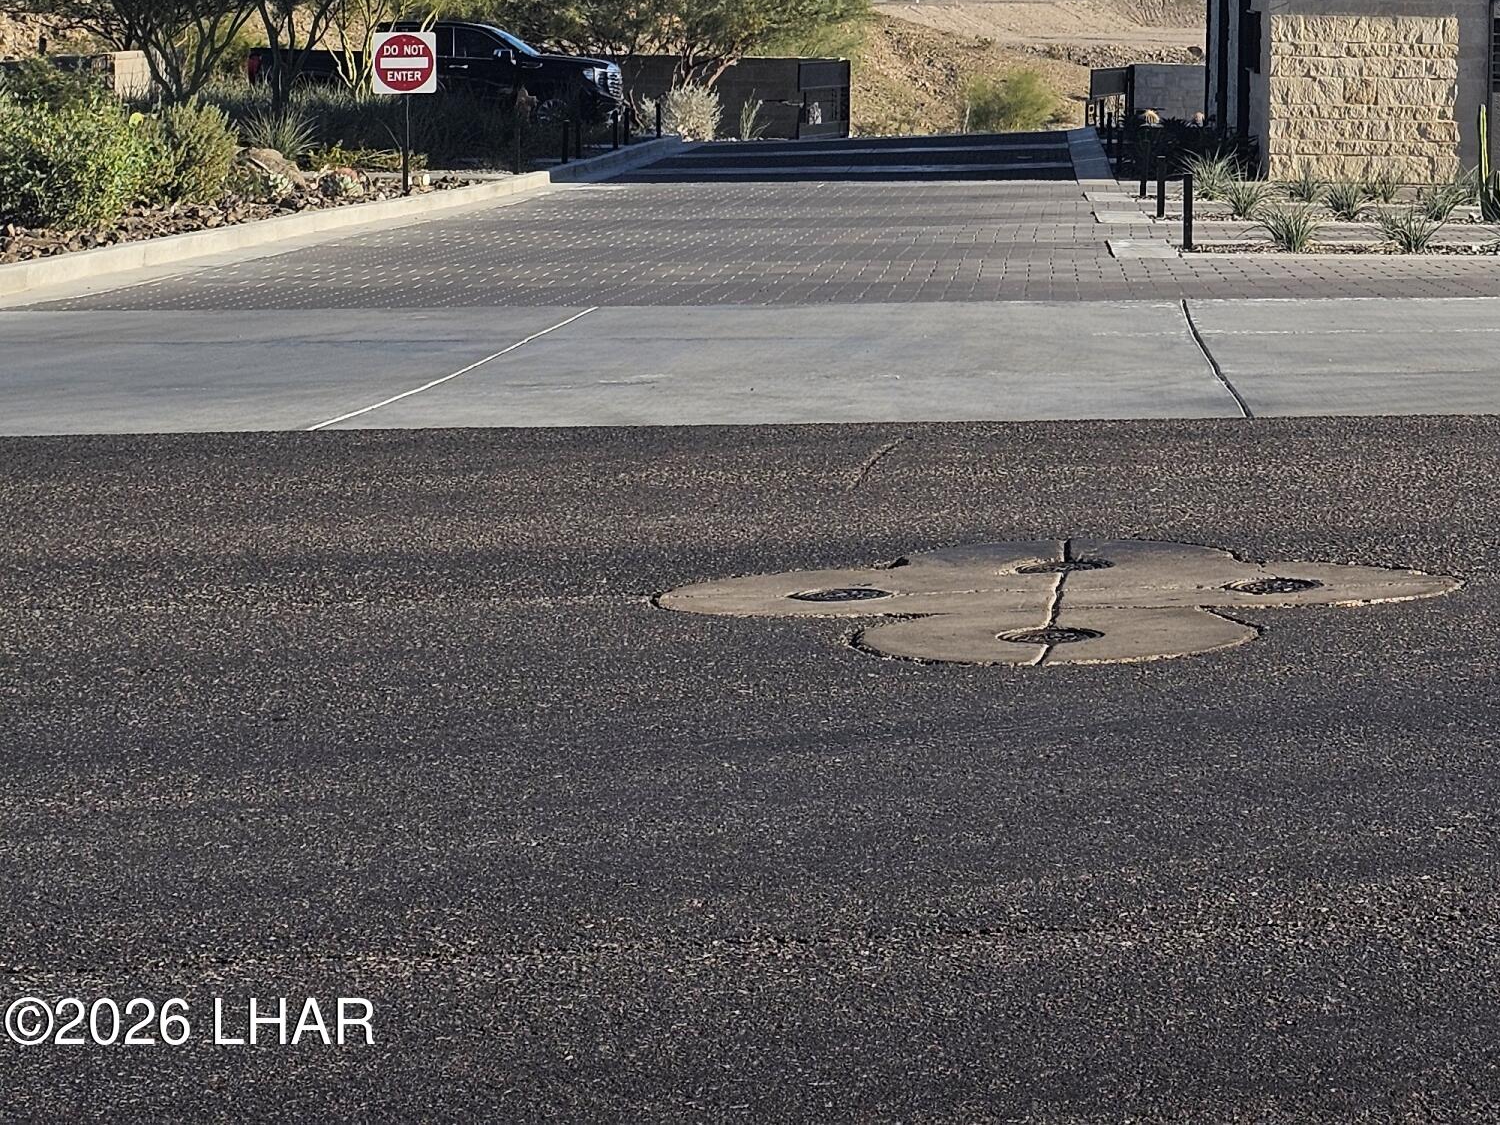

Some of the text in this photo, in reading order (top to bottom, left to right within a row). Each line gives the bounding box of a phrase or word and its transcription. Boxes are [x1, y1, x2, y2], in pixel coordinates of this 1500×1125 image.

[383, 44, 425, 56] DO NOT
[387, 70, 422, 82] ENTER
